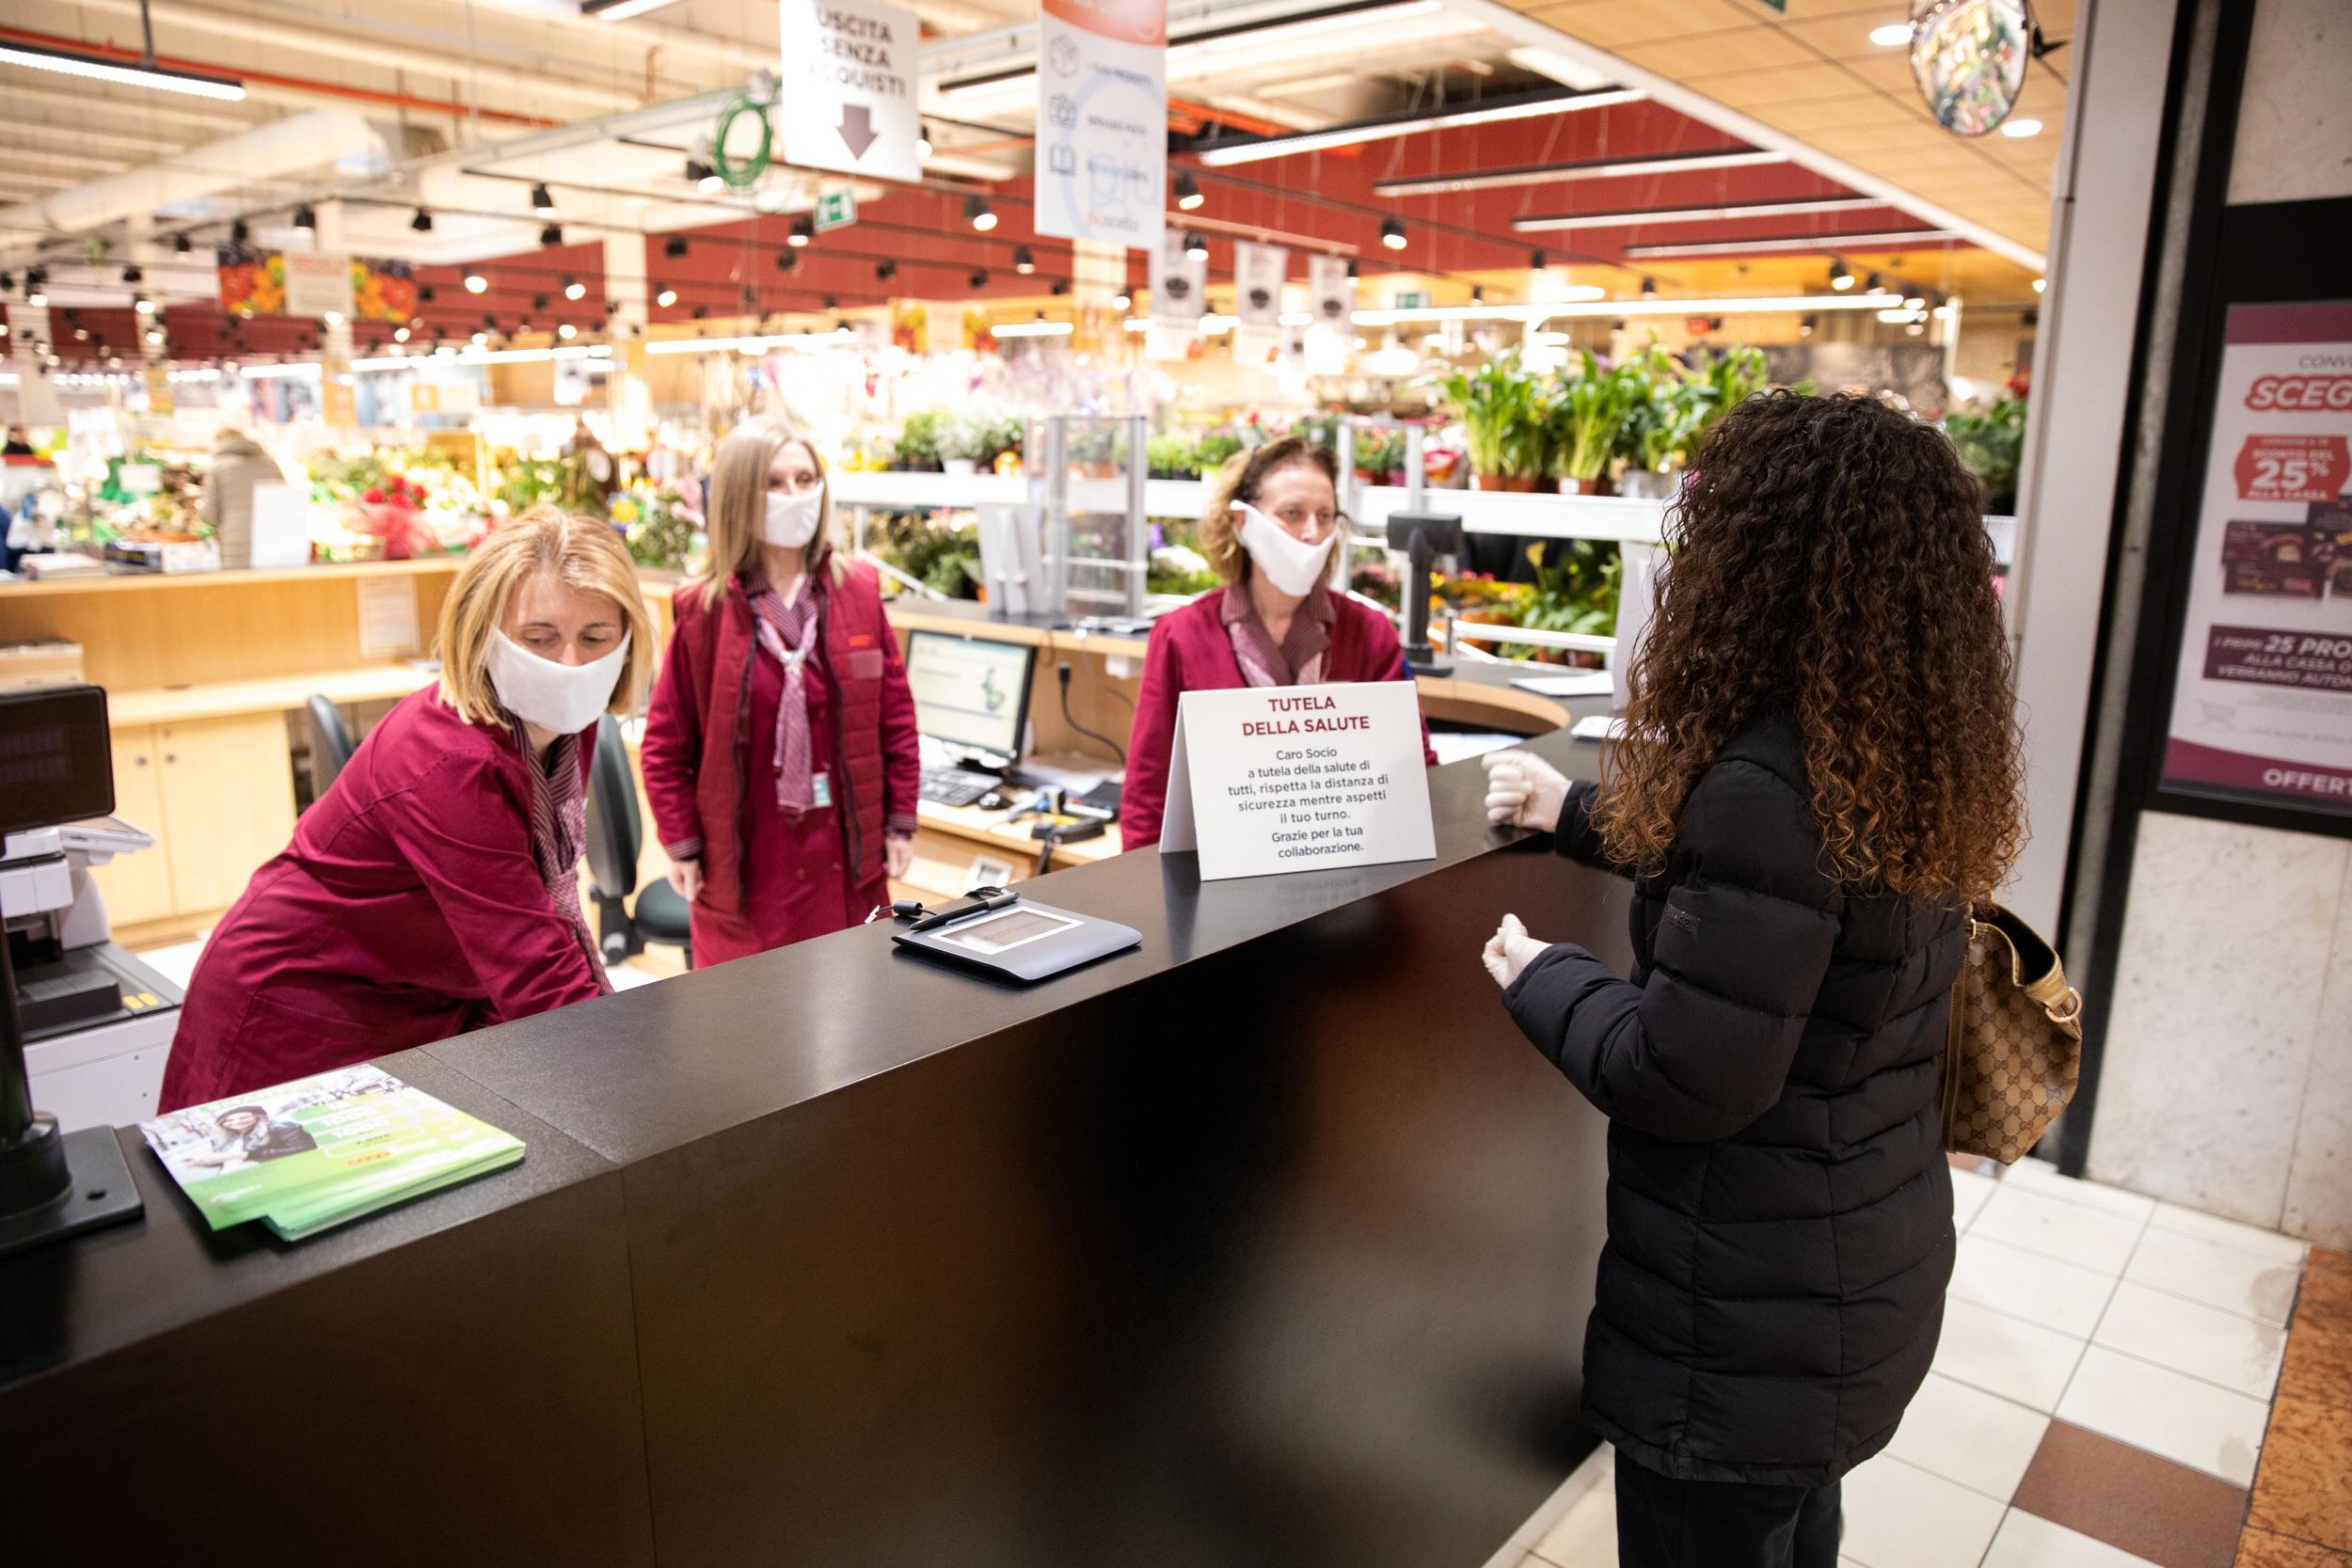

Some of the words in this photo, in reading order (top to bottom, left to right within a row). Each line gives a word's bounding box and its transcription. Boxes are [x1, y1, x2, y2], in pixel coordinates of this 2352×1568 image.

[817, 7, 893, 42] USCITA
[821, 37, 890, 67] SENZA
[808, 63, 906, 98] QUISTI
[2251, 379, 2352, 406] SCEG
[2264, 635, 2296, 654] 25
[2298, 637, 2352, 658] PRO
[1268, 696, 1336, 712] TUTELA
[1243, 720, 1299, 736] DELLA
[1305, 716, 1370, 733] SALUTE
[1276, 750, 1303, 761] Caro
[1306, 747, 1337, 759] Socio
[1248, 769, 1255, 779] a
[1258, 765, 1291, 778] tutela
[1295, 763, 1321, 776] della
[1325, 761, 1357, 773] salute
[1359, 759, 1370, 771] di
[1228, 784, 1256, 797] tutti,
[1260, 780, 1307, 795] rispetta
[1311, 779, 1321, 791] la
[1325, 776, 1374, 789] distanza
[1377, 774, 1389, 785] di
[1238, 798, 1295, 812] sicurezza
[1300, 794, 1342, 807] mentre
[1346, 790, 1386, 806] aspetti
[1279, 813, 1287, 825] il
[1291, 812, 1311, 823] tuo
[1315, 810, 1350, 822] turno.
[1272, 832, 1308, 843] Grazie
[1311, 830, 1329, 842] per
[1333, 827, 1343, 839] la
[1346, 826, 1363, 837] tua
[1278, 841, 1363, 858] collaborazione.
